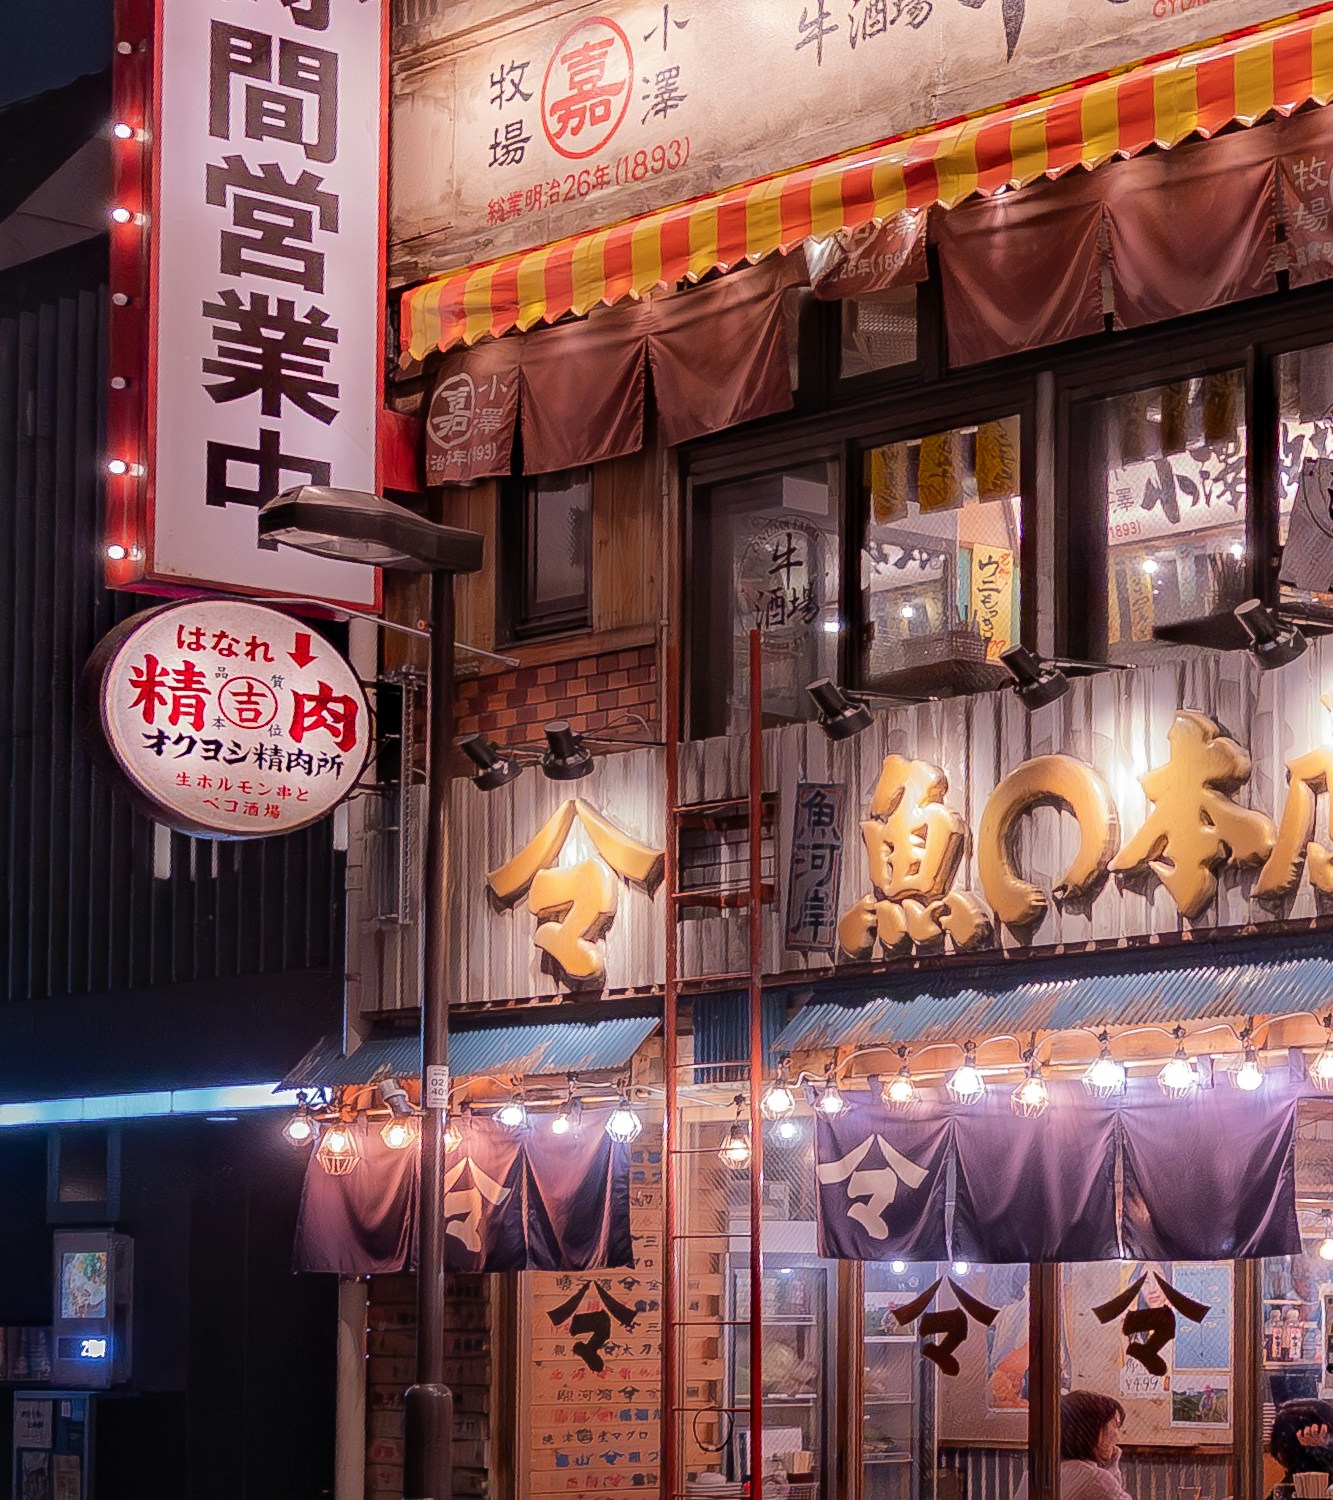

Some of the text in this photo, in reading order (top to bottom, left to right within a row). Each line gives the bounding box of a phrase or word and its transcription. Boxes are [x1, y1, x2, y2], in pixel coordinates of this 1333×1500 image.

[549, 37, 626, 138] 嘉
[640, 2, 690, 126] 小澤
[487, 59, 533, 170] 牧場
[768, 532, 803, 590] 牛
[176, 624, 275, 663] はなれ
[755, 582, 820, 629] 酒場
[128, 654, 212, 731] 精
[288, 680, 358, 752] 肉
[142, 728, 344, 780] オクヨシ精肉所
[175, 772, 310, 802] 生ホルモン串と
[790, 783, 843, 952] 魚河岸
